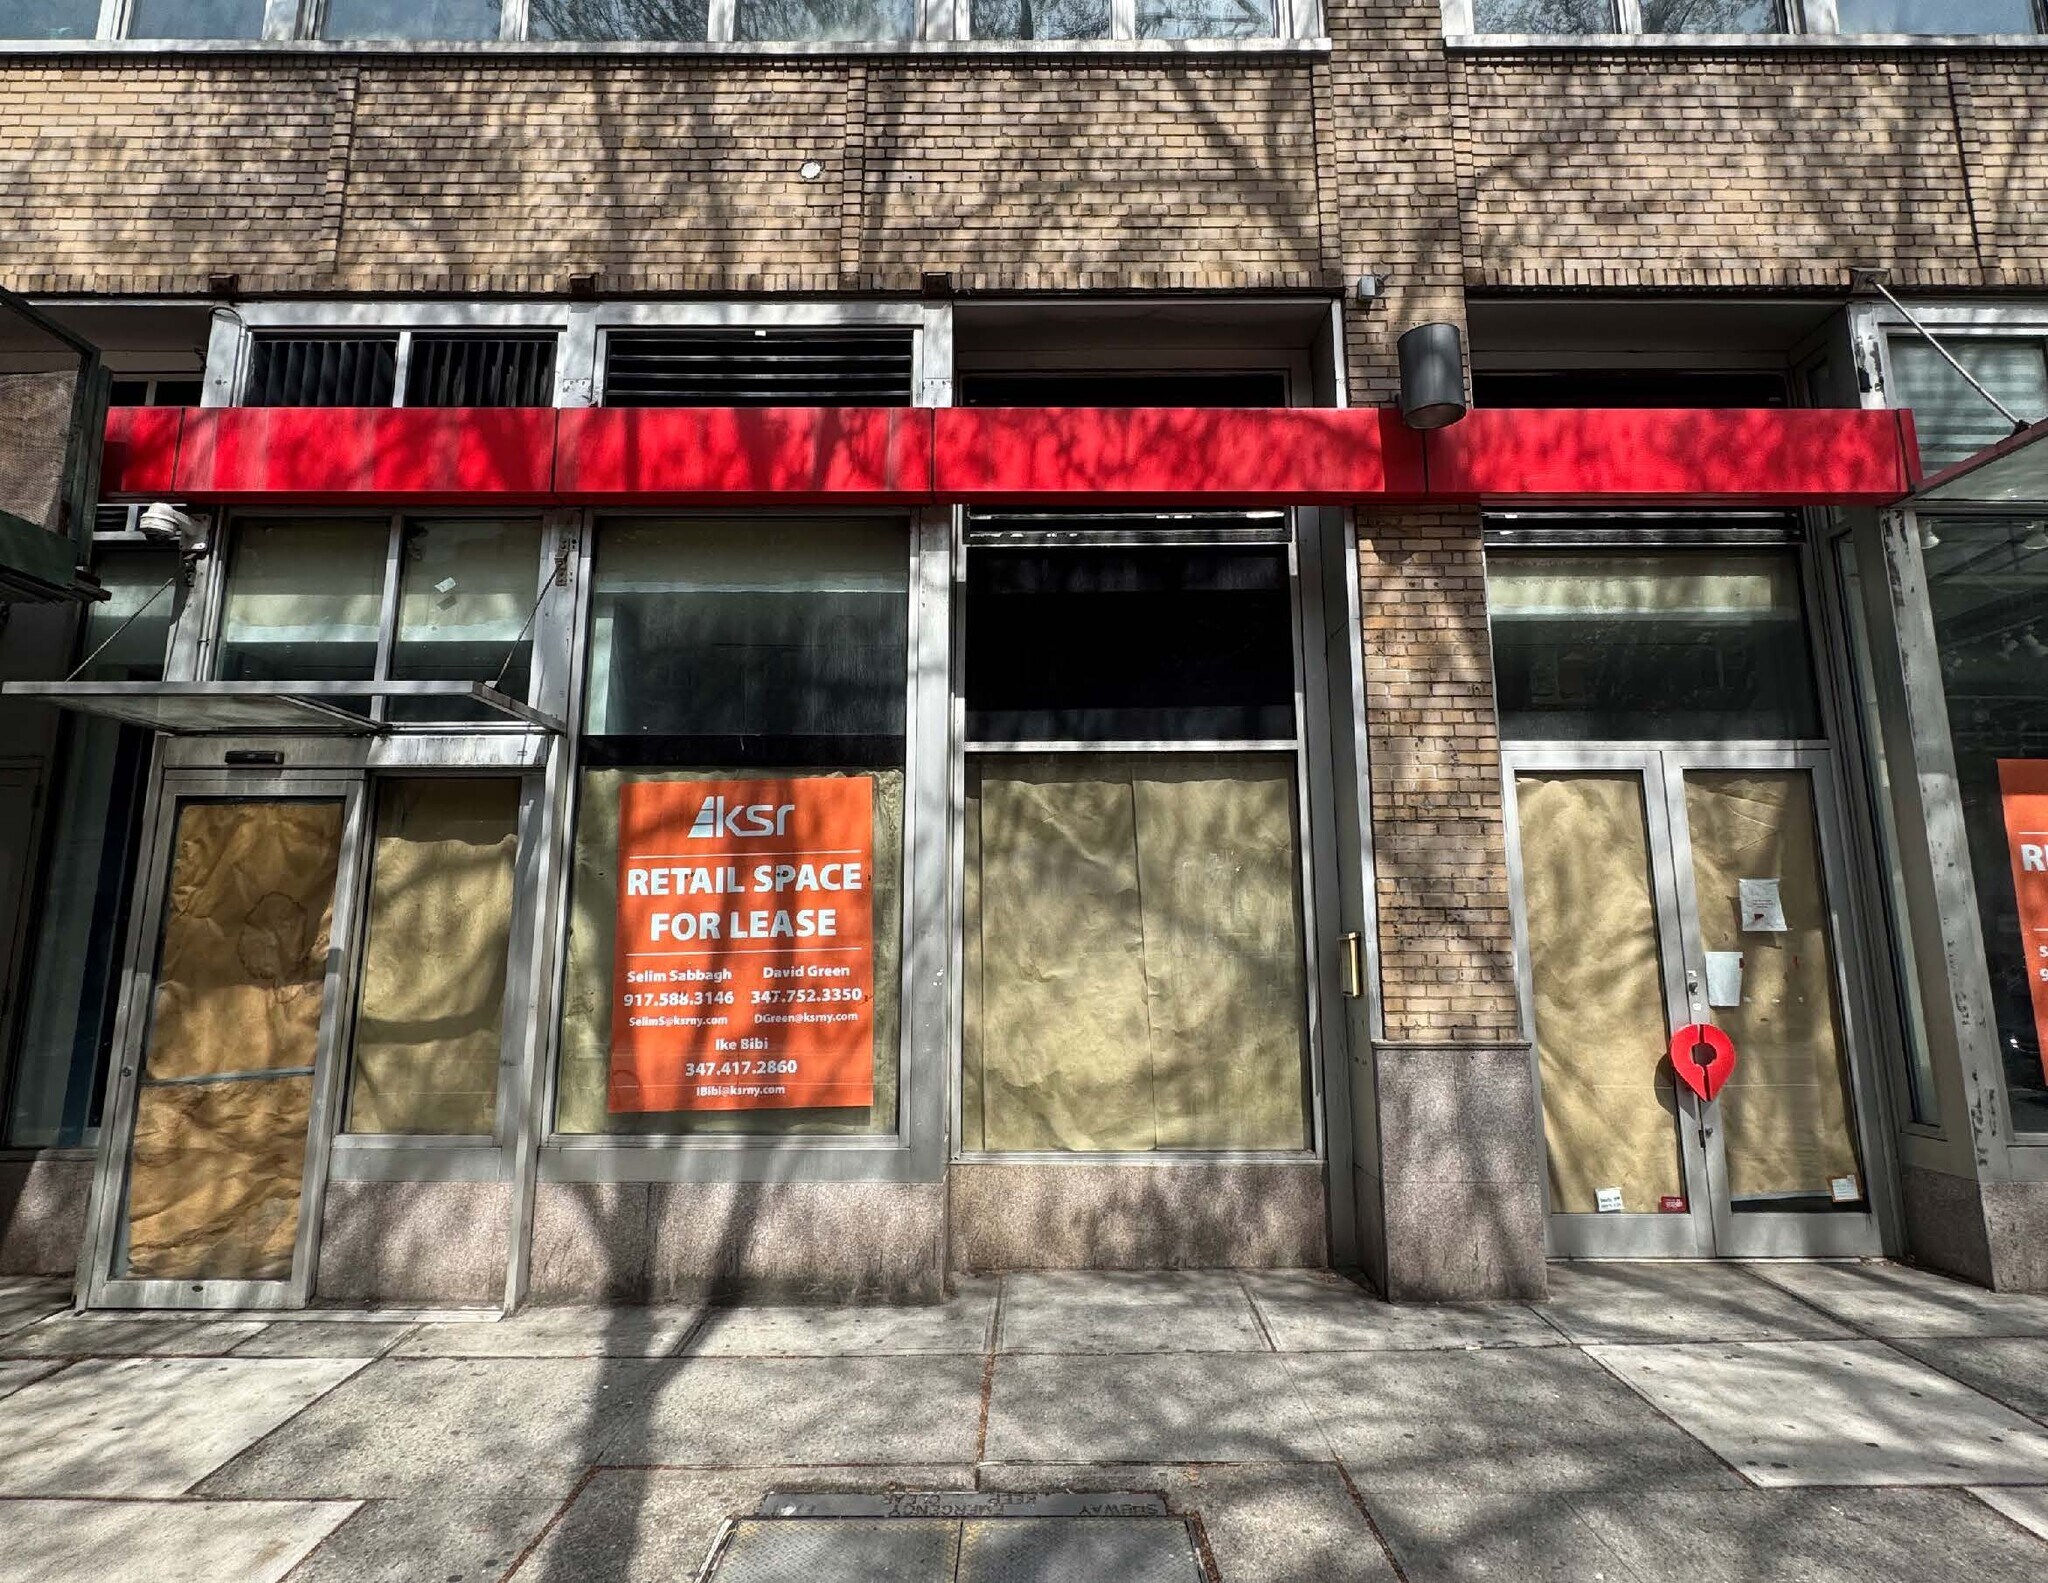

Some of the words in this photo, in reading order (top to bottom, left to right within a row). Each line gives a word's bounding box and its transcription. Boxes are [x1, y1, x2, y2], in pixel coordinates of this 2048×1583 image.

[628, 868, 745, 896] RETAIL
[753, 863, 862, 892] SPACE
[650, 912, 721, 941] FOR
[730, 909, 837, 938] LEASE
[627, 970, 666, 983] Selim
[669, 968, 732, 983] Sabbagh
[763, 965, 804, 979] David
[807, 965, 850, 977] Green
[750, 987, 862, 1004] 347.752.3350
[715, 1038, 737, 1050] Ike
[740, 1037, 768, 1049] Bibi
[685, 1060, 797, 1076] 347.417.2860
